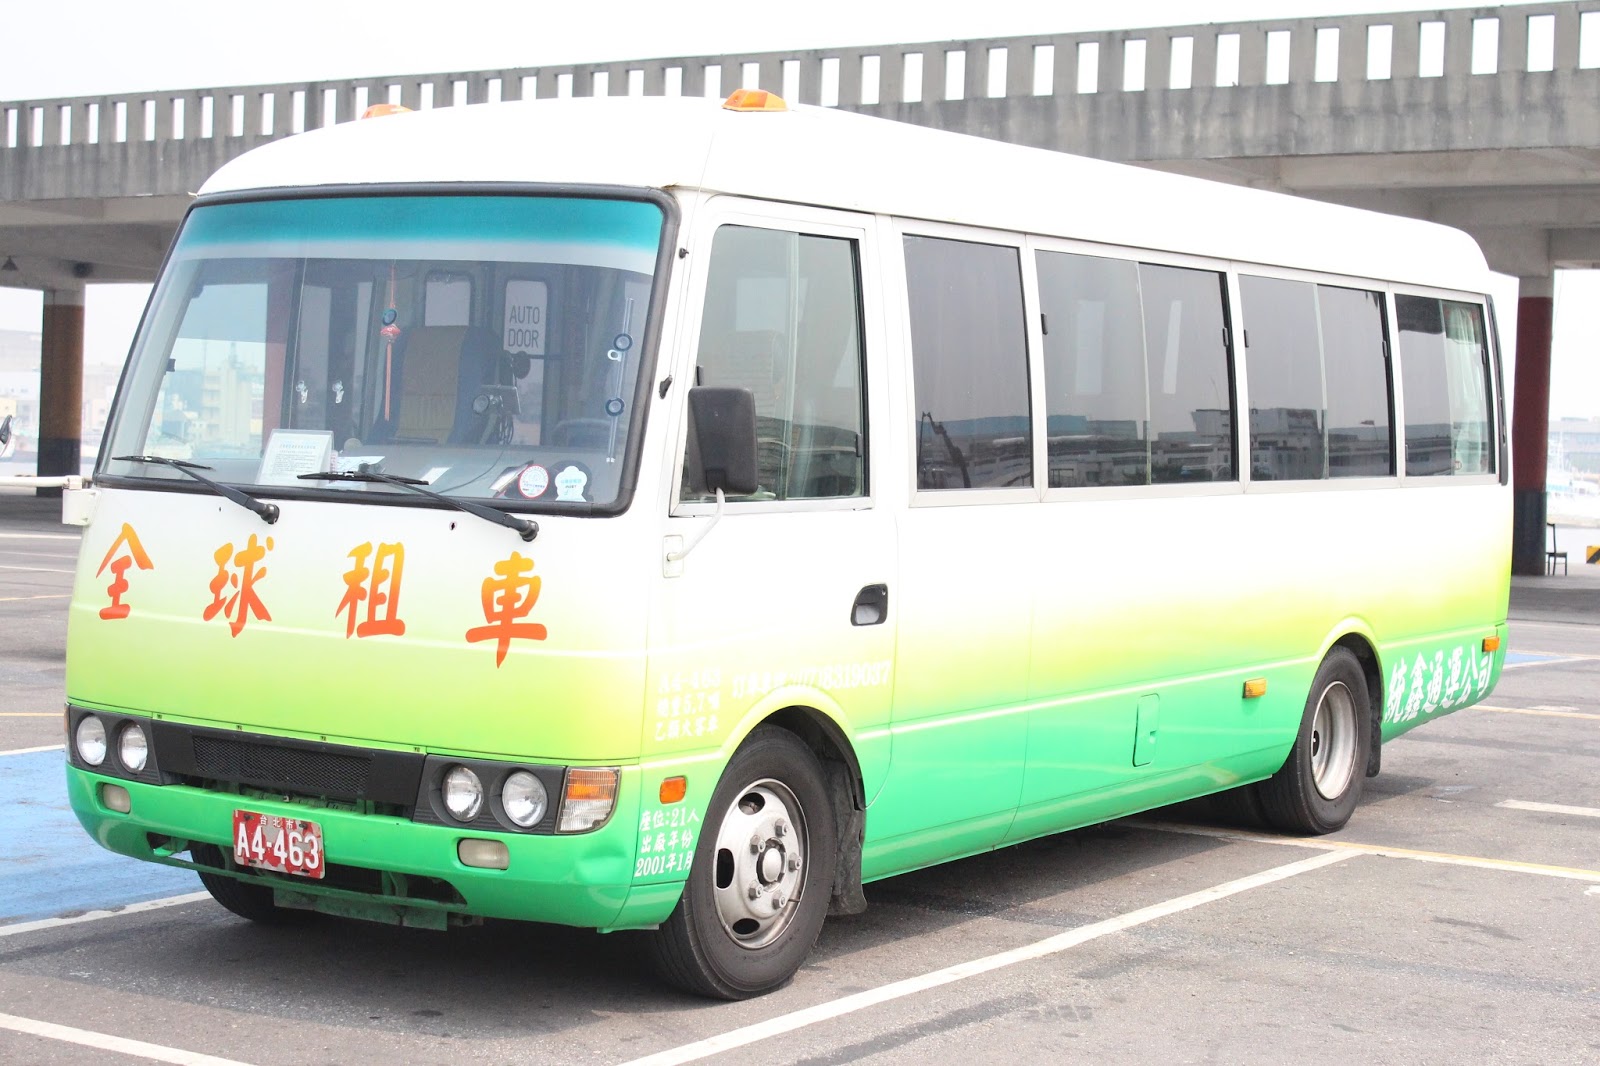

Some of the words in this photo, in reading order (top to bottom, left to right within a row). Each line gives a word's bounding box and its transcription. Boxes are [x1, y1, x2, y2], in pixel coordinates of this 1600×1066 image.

[509, 304, 540, 325] AUTO
[508, 329, 539, 348] DOOR
[96, 522, 548, 668] 全球租車
[260, 814, 294, 829] 台北市
[639, 807, 700, 832] 座位:21人
[237, 822, 319, 869] A4-463
[634, 850, 693, 878] 2001年1月
